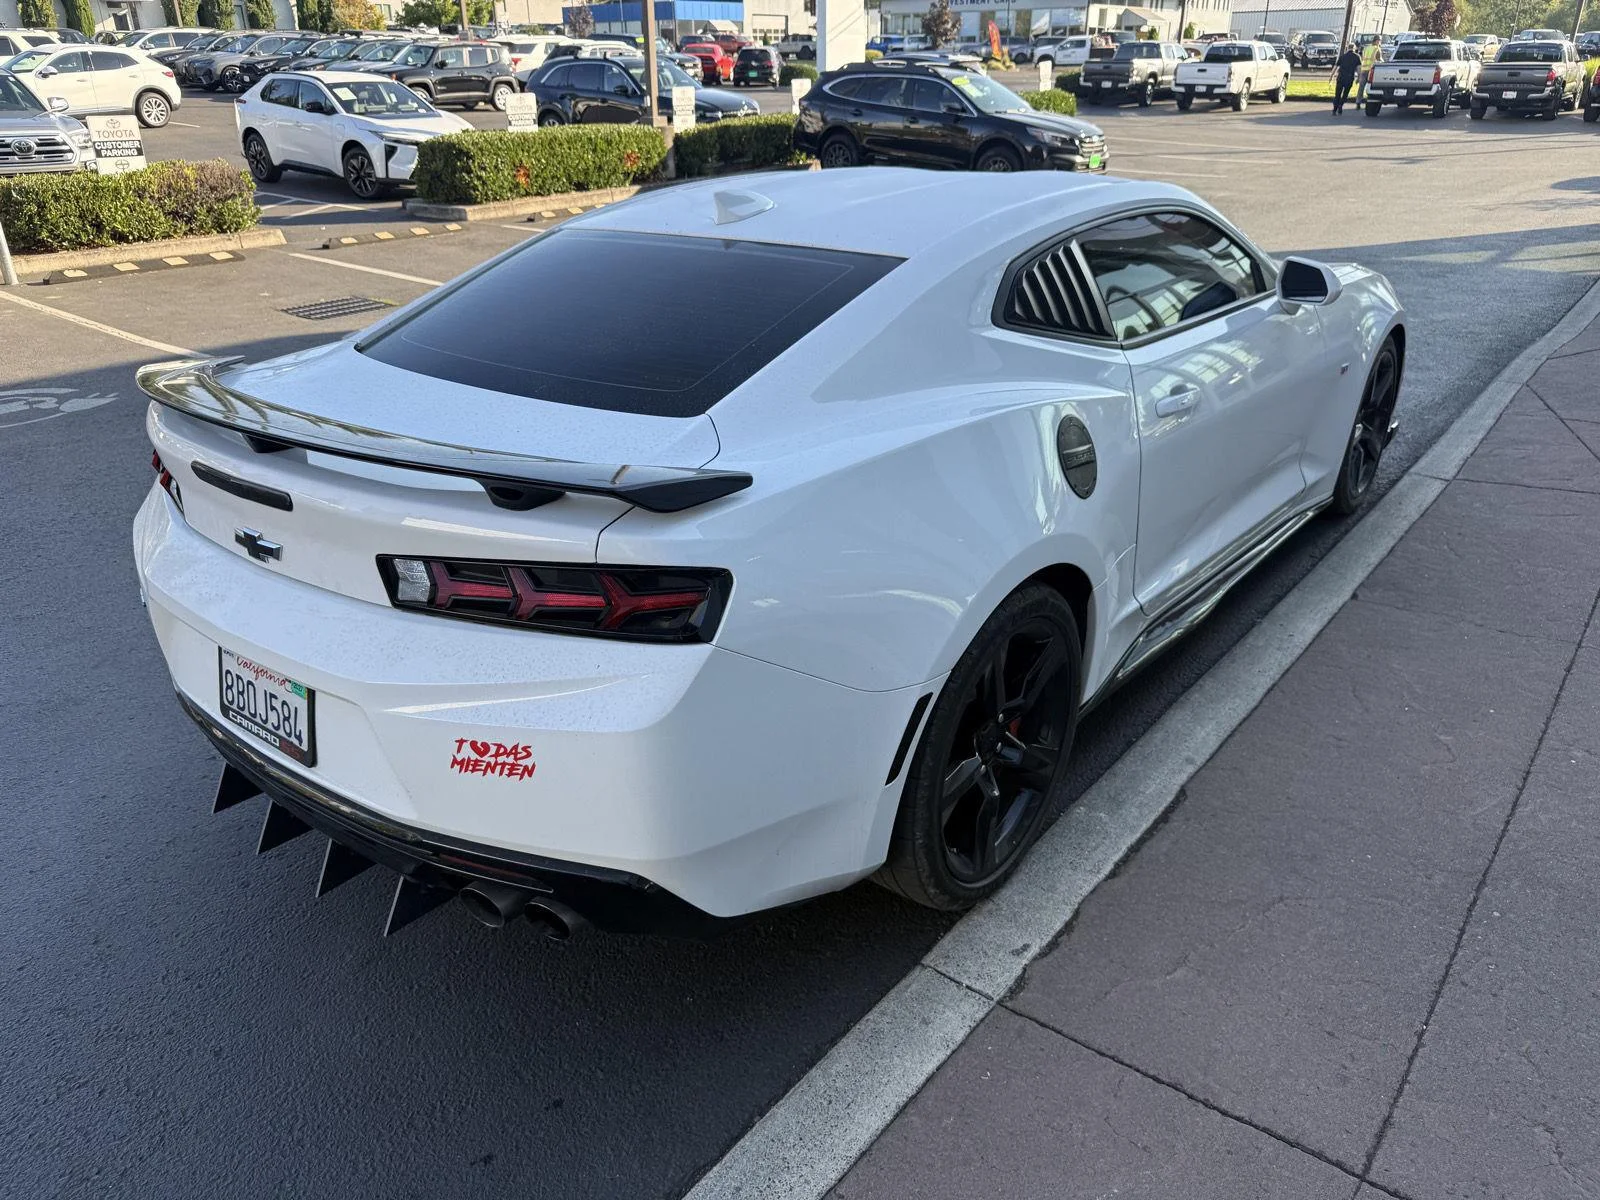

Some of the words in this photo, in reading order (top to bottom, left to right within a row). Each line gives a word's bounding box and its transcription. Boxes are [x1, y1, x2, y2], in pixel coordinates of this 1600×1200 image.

[96, 130, 136, 138] TOYOTA
[95, 141, 140, 149] CUSTOMER
[229, 710, 280, 747] CAMARO
[450, 754, 536, 781] MIENTEN
